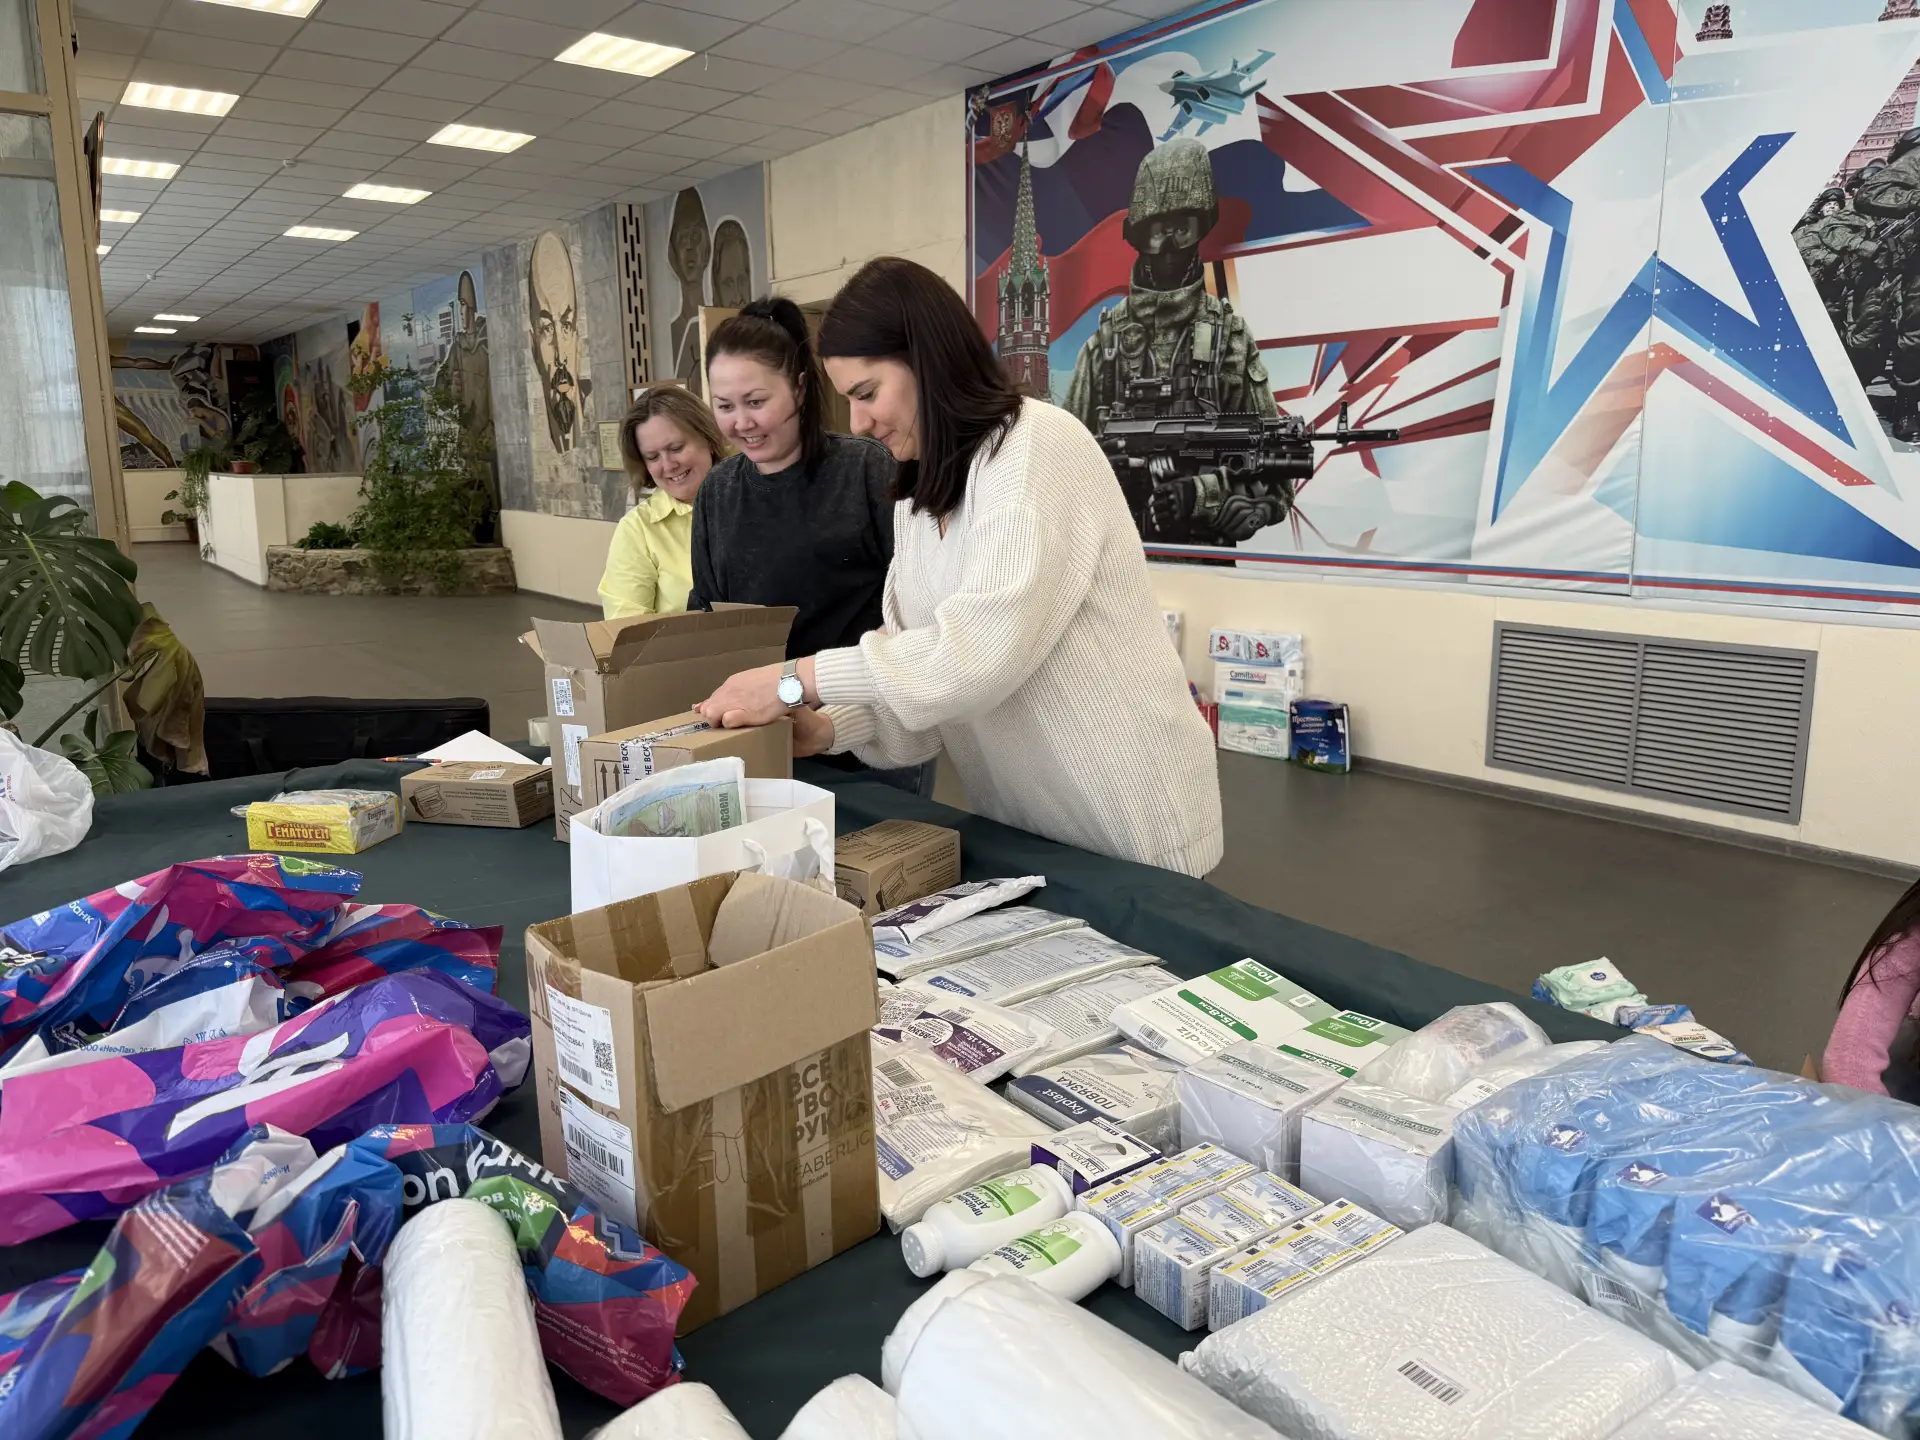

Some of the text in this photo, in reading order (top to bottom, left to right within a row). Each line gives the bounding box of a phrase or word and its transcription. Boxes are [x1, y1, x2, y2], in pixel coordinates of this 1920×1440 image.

[718, 792, 731, 832] осаем
[1243, 960, 1273, 982] 10шт
[1344, 1012, 1376, 1029] 10шт
[1043, 1088, 1088, 1116] fixplast
[1056, 1076, 1118, 1110] ПОВЯЗКА
[403, 1167, 460, 1205] on
[1103, 1188, 1130, 1205] Бинт
[953, 1193, 983, 1217] ПРИСЫПК
[1332, 1212, 1357, 1227] Бинт
[1288, 1233, 1314, 1249] Бинт
[993, 1248, 1026, 1270] ПРИСЫПК
[1240, 1257, 1268, 1273] Бинт
